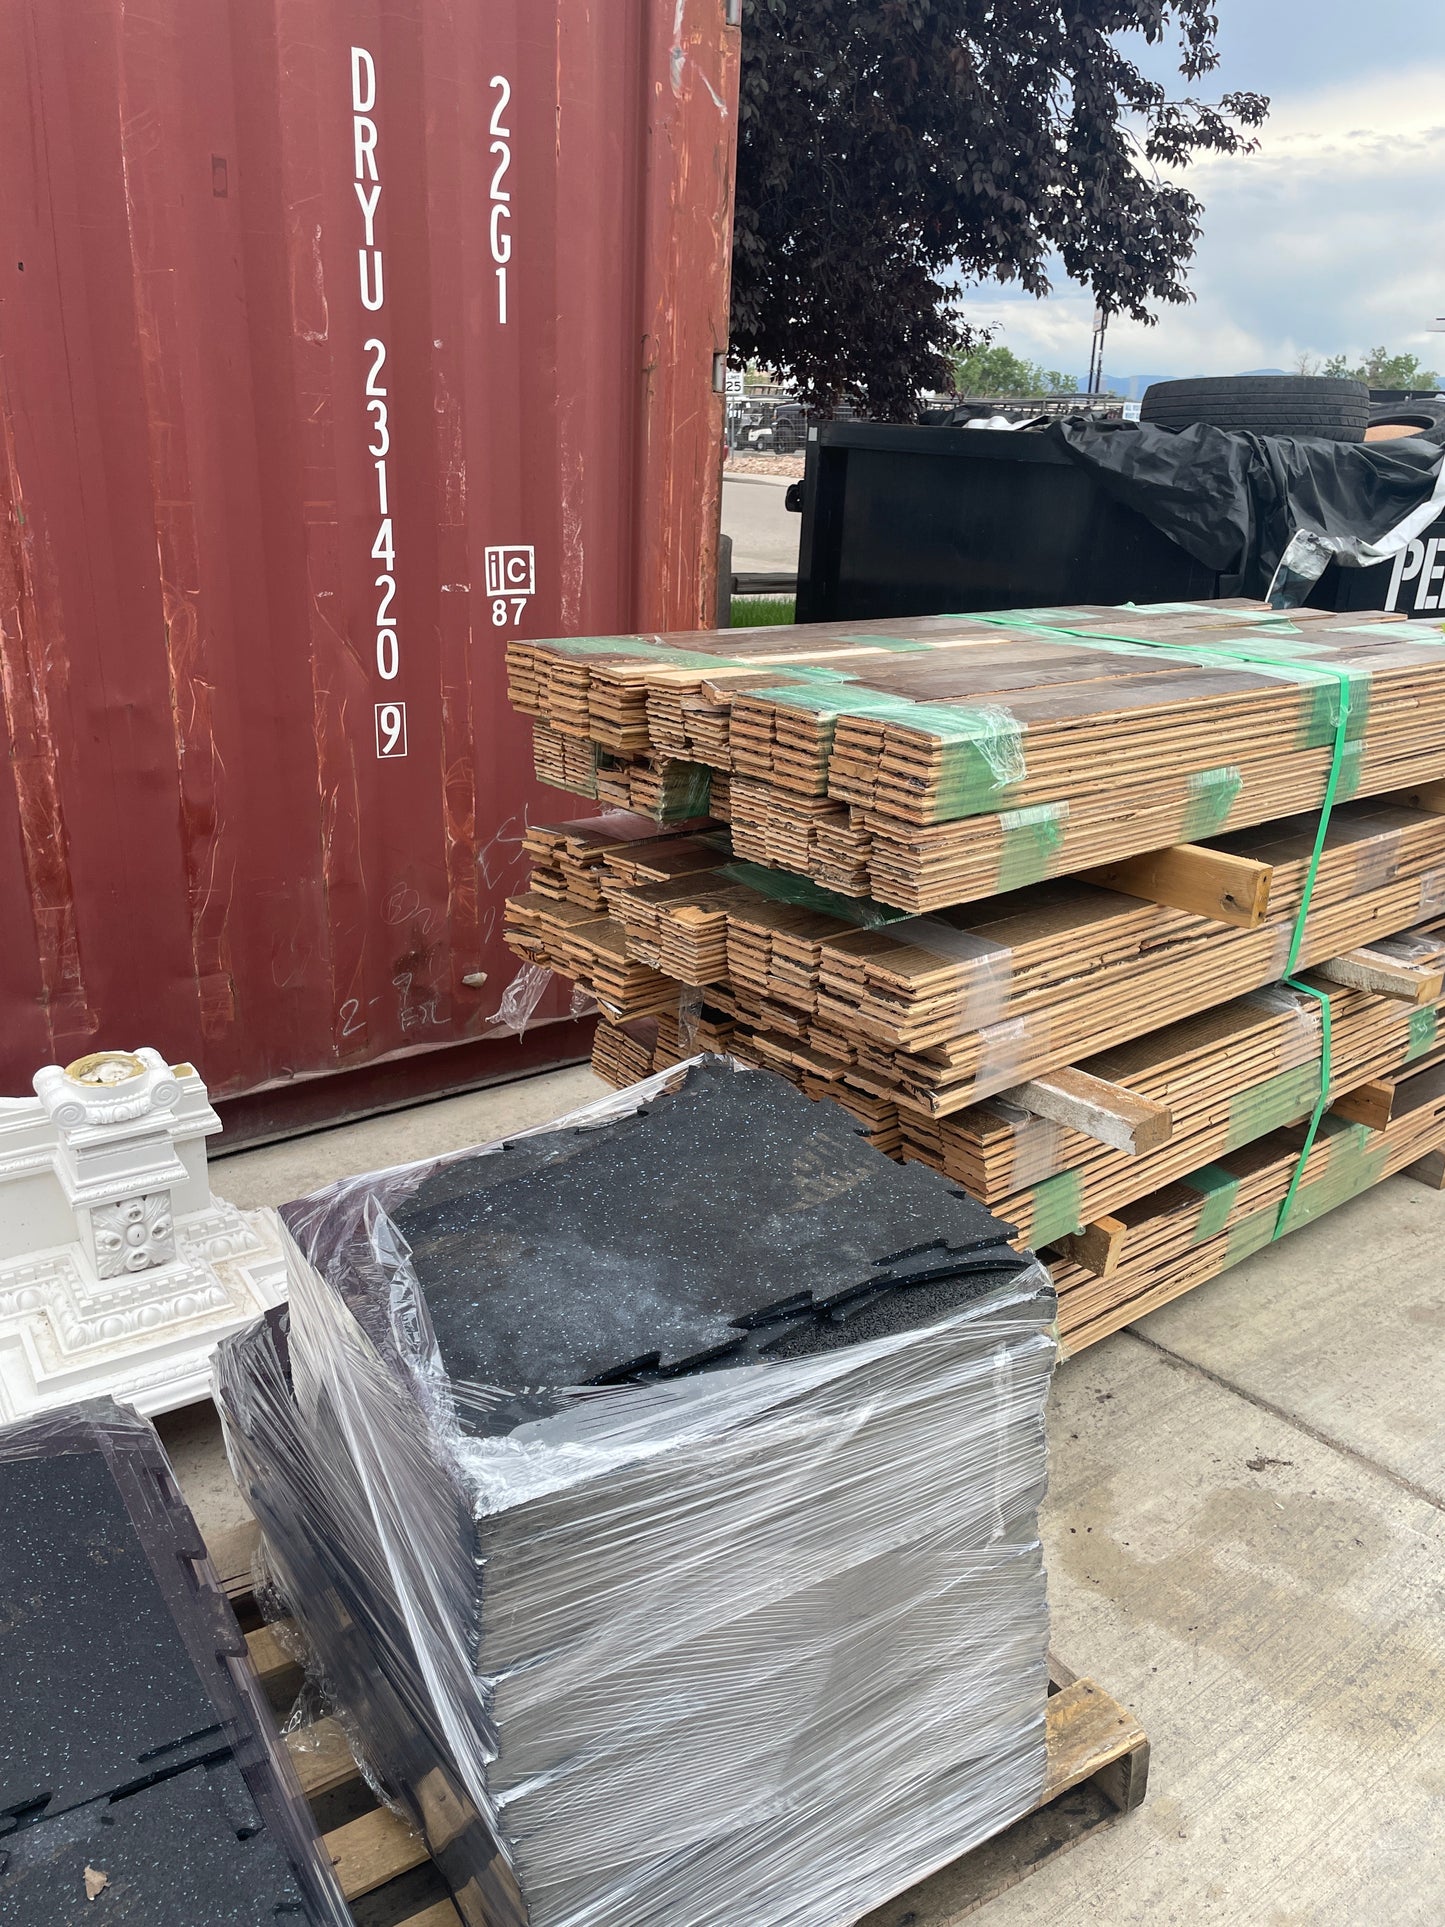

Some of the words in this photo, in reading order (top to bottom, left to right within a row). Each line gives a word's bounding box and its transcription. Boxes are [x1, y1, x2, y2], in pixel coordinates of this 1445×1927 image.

[350, 46, 384, 311] DRYU
[489, 75, 511, 325] 22G1
[726, 381, 742, 392] 25
[363, 338, 399, 680] 231420
[491, 598, 527, 627] 87
[380, 705, 401, 756] 9
